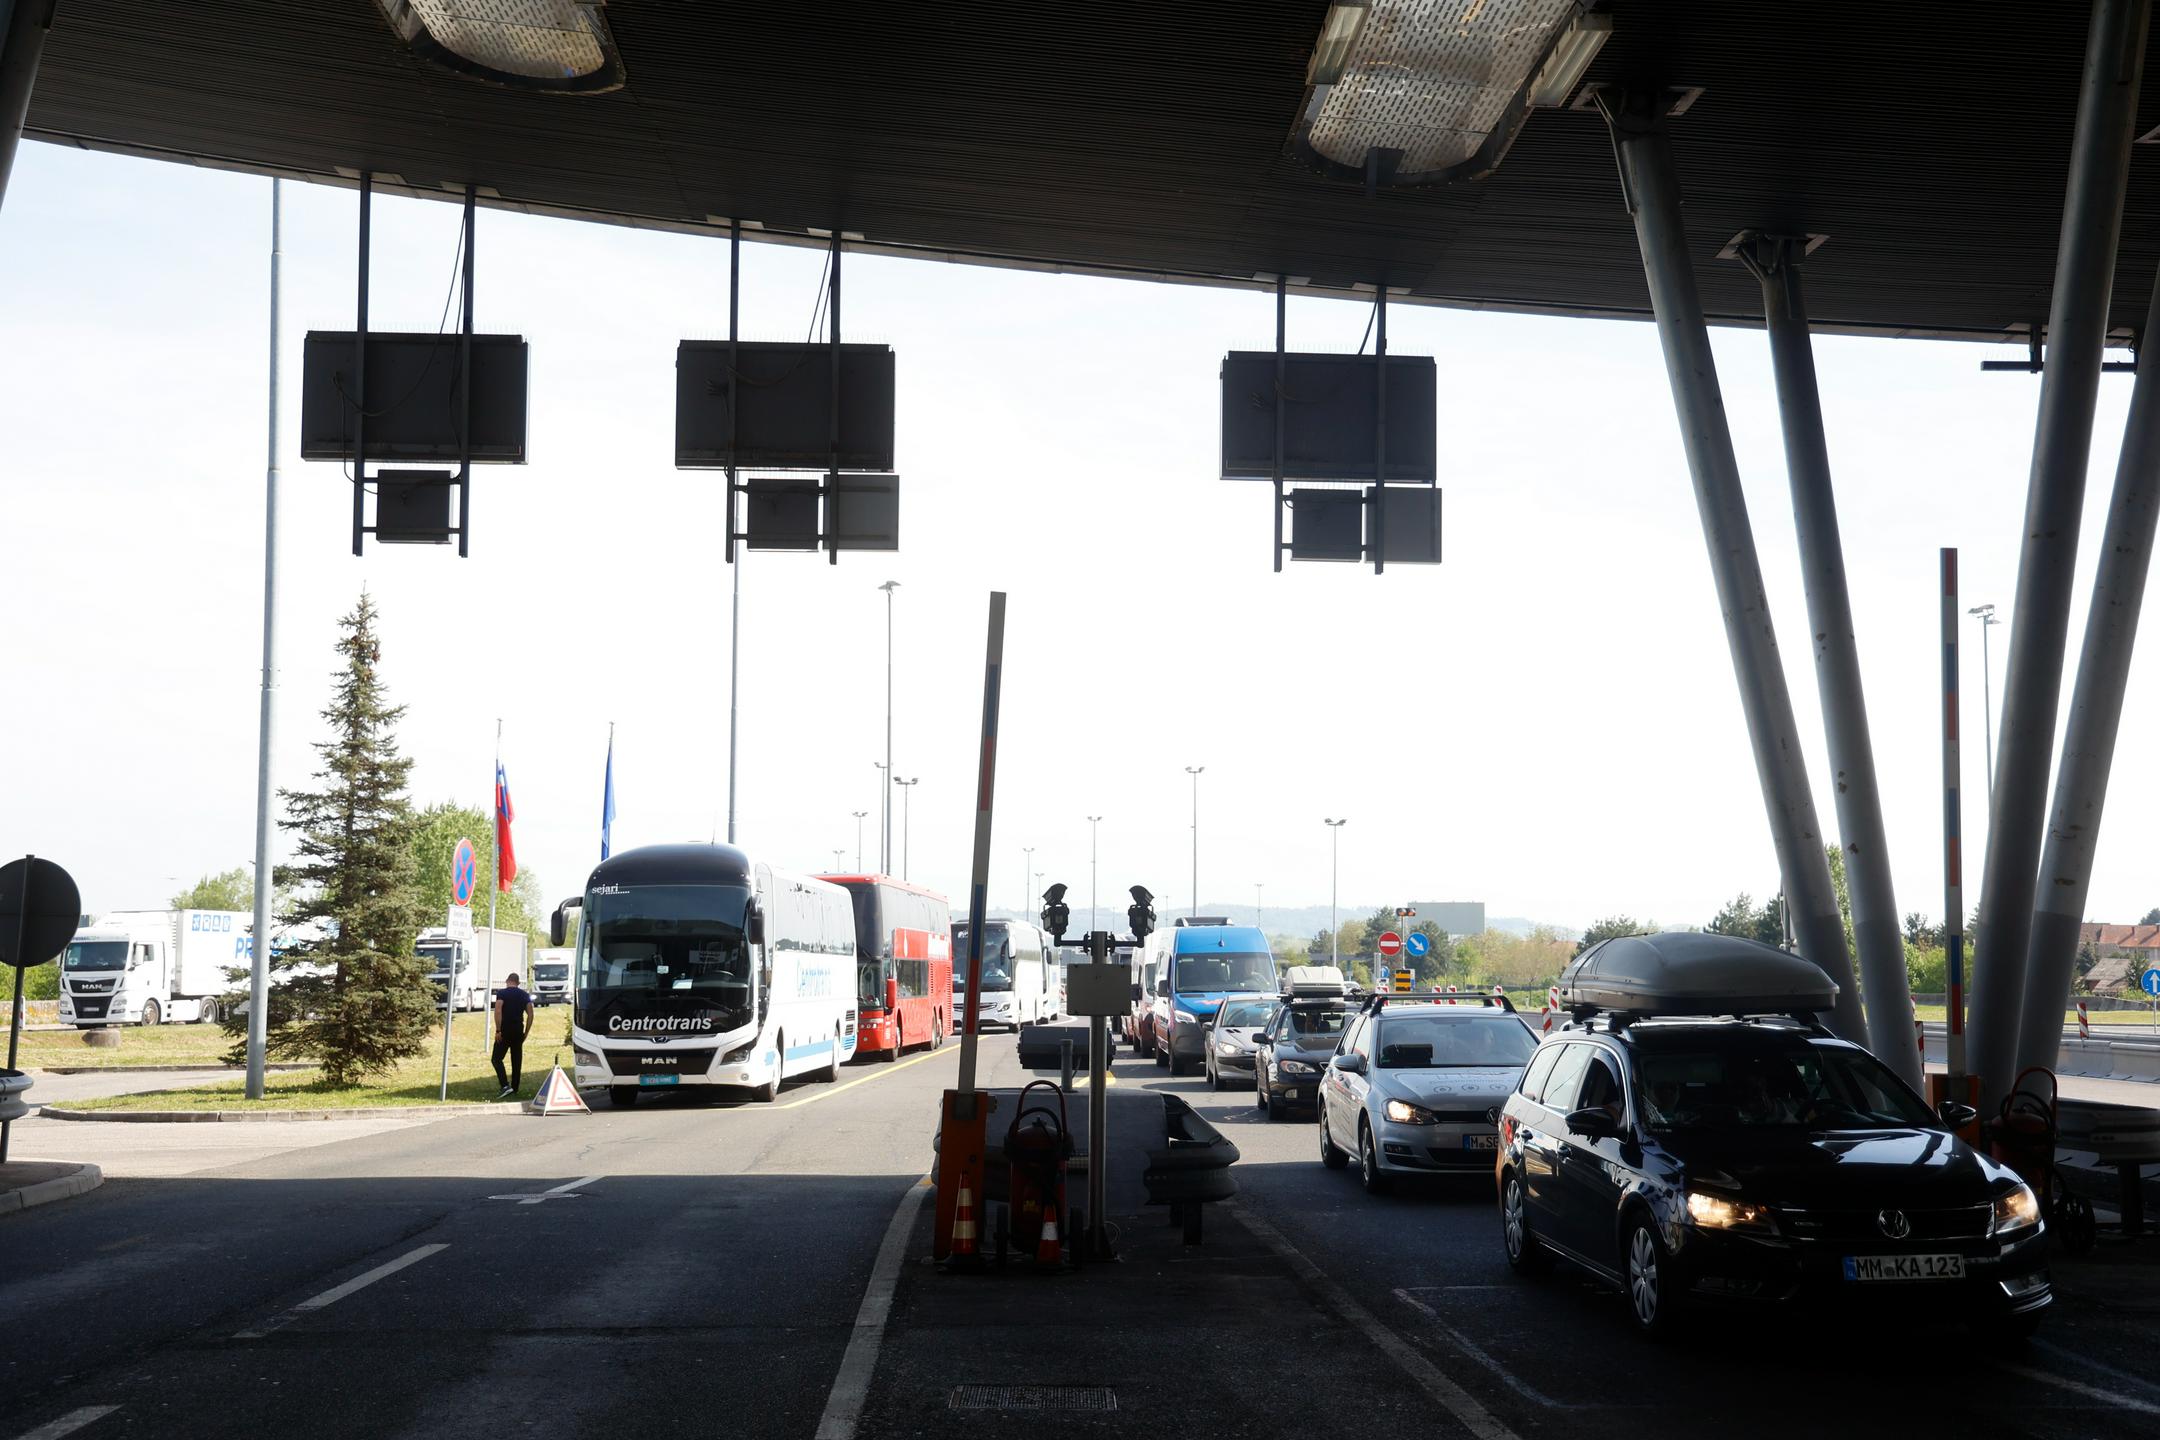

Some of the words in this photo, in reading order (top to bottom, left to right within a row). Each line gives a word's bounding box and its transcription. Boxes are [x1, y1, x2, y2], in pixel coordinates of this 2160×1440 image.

[608, 1014, 712, 1031] Centrotrans
[641, 1056, 678, 1065] MAN
[1855, 1258, 1883, 1278] MM
[1894, 1257, 1921, 1277] KA
[1924, 1256, 1962, 1276] 123
